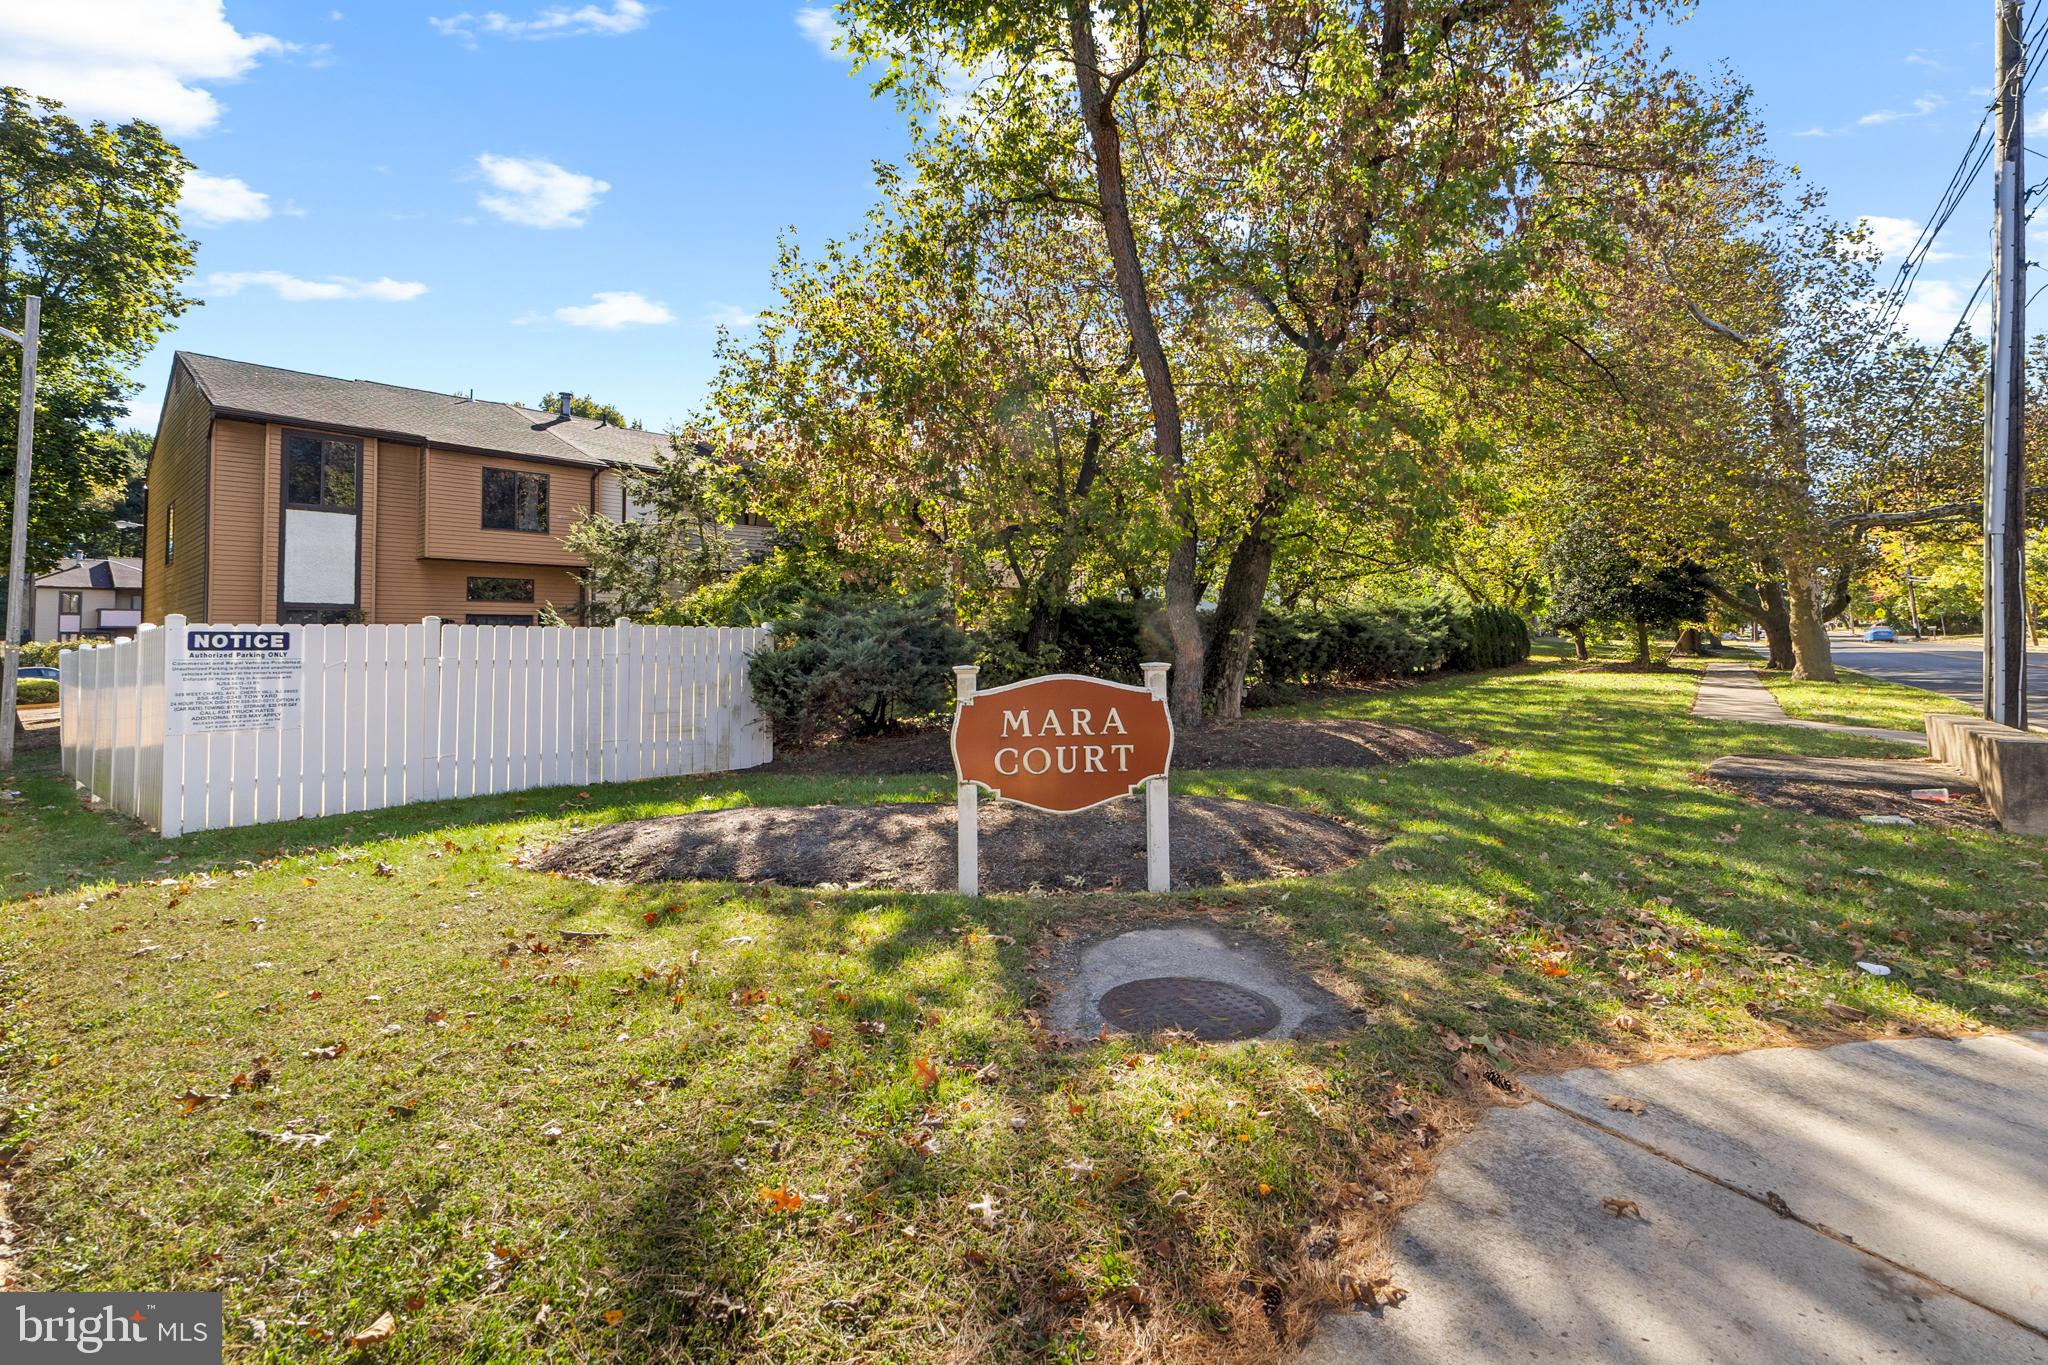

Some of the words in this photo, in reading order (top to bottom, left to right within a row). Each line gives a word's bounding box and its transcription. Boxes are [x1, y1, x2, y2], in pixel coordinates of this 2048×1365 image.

[194, 634, 284, 648] NOTICE
[1000, 707, 1127, 738] MARA
[994, 744, 1134, 775] COURT
